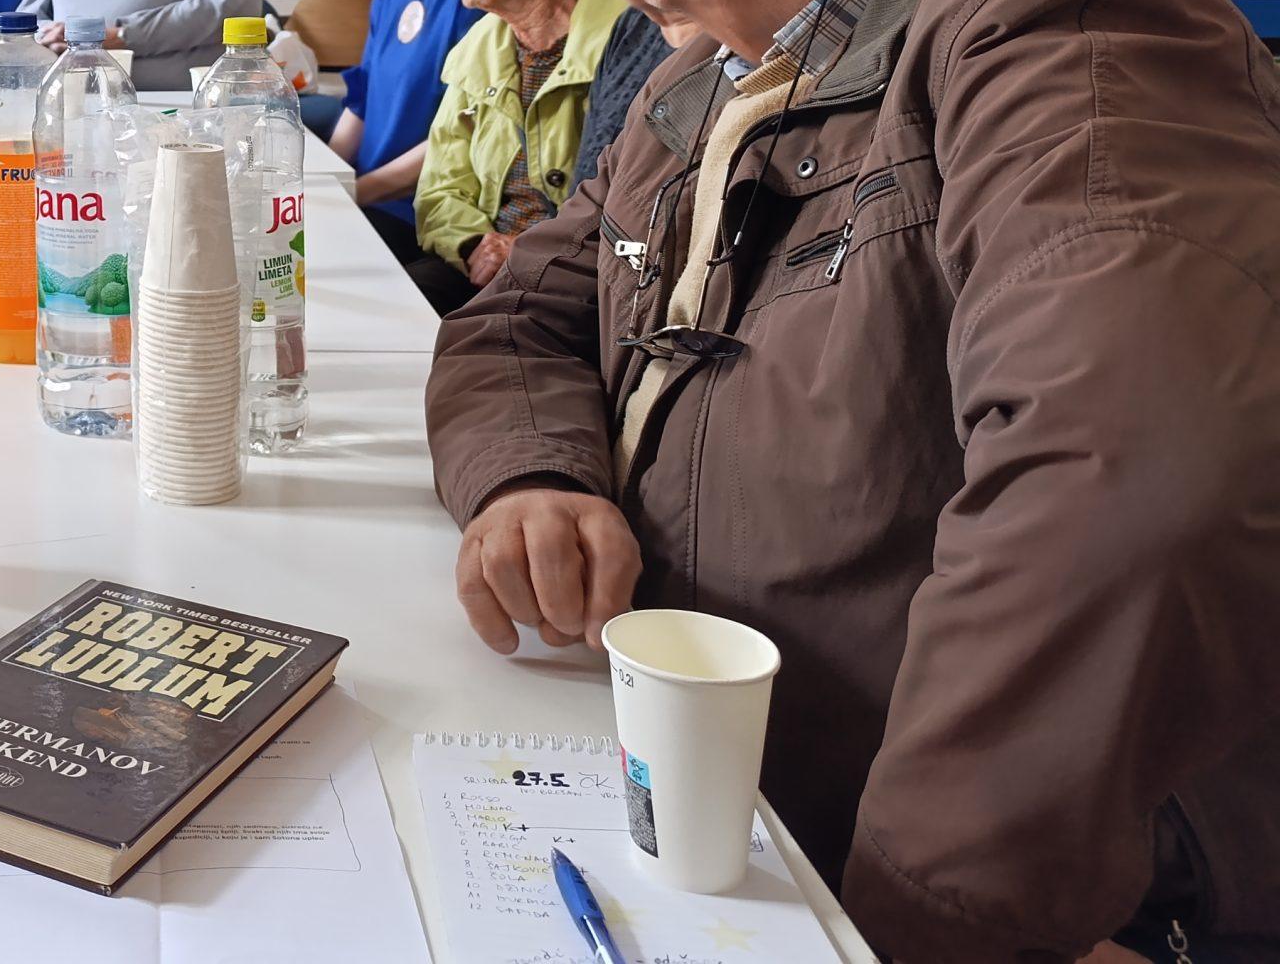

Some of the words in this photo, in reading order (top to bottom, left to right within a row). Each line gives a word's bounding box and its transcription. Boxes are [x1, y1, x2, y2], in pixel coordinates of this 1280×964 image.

[258, 265, 293, 281] LIMETA
[263, 253, 293, 269] LIMUN
[102, 589, 133, 602] NEW
[136, 596, 173, 611] YORK
[176, 606, 218, 623] TIMES
[221, 618, 313, 645] BESTSELLER
[64, 601, 288, 676] ROBERT
[14, 630, 254, 716] LUDLUM
[512, 769, 571, 788] 27.5
